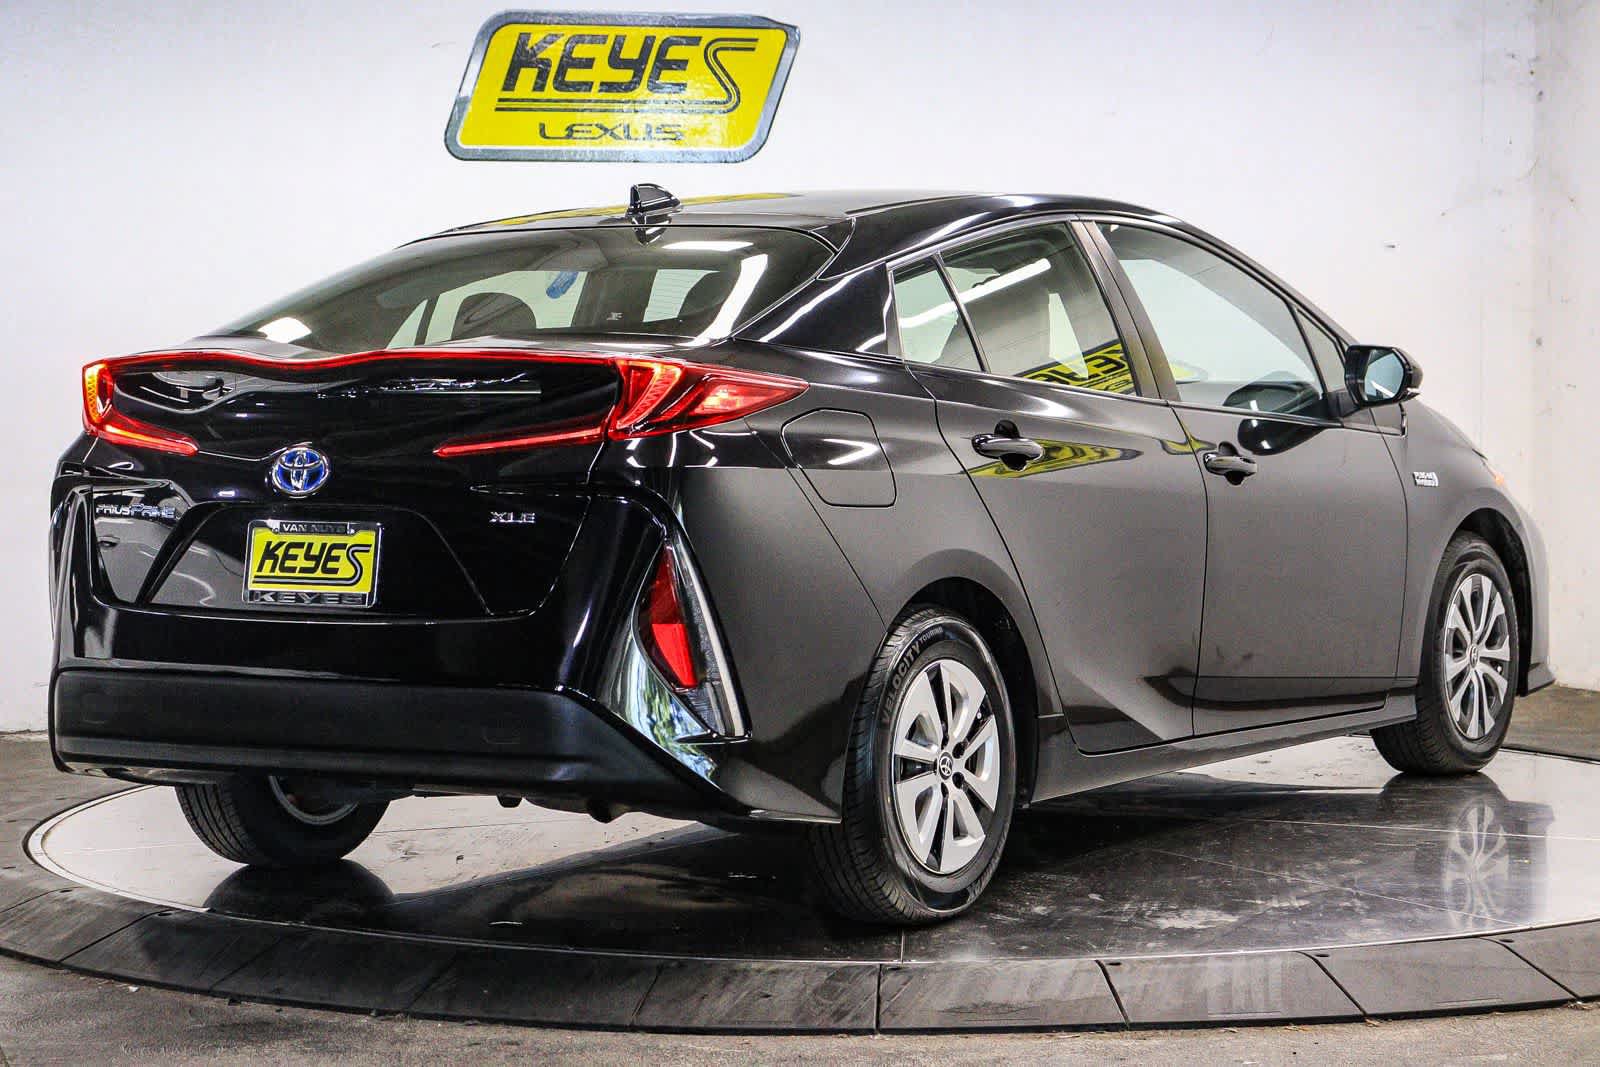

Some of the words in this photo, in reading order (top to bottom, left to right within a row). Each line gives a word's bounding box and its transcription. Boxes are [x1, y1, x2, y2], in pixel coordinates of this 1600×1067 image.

[495, 32, 759, 114] KEYES
[539, 122, 684, 141] LEXUS
[489, 511, 535, 523] XLE
[282, 523, 308, 533] VAN
[252, 541, 372, 587] KEYES
[253, 591, 363, 604] KEYES
